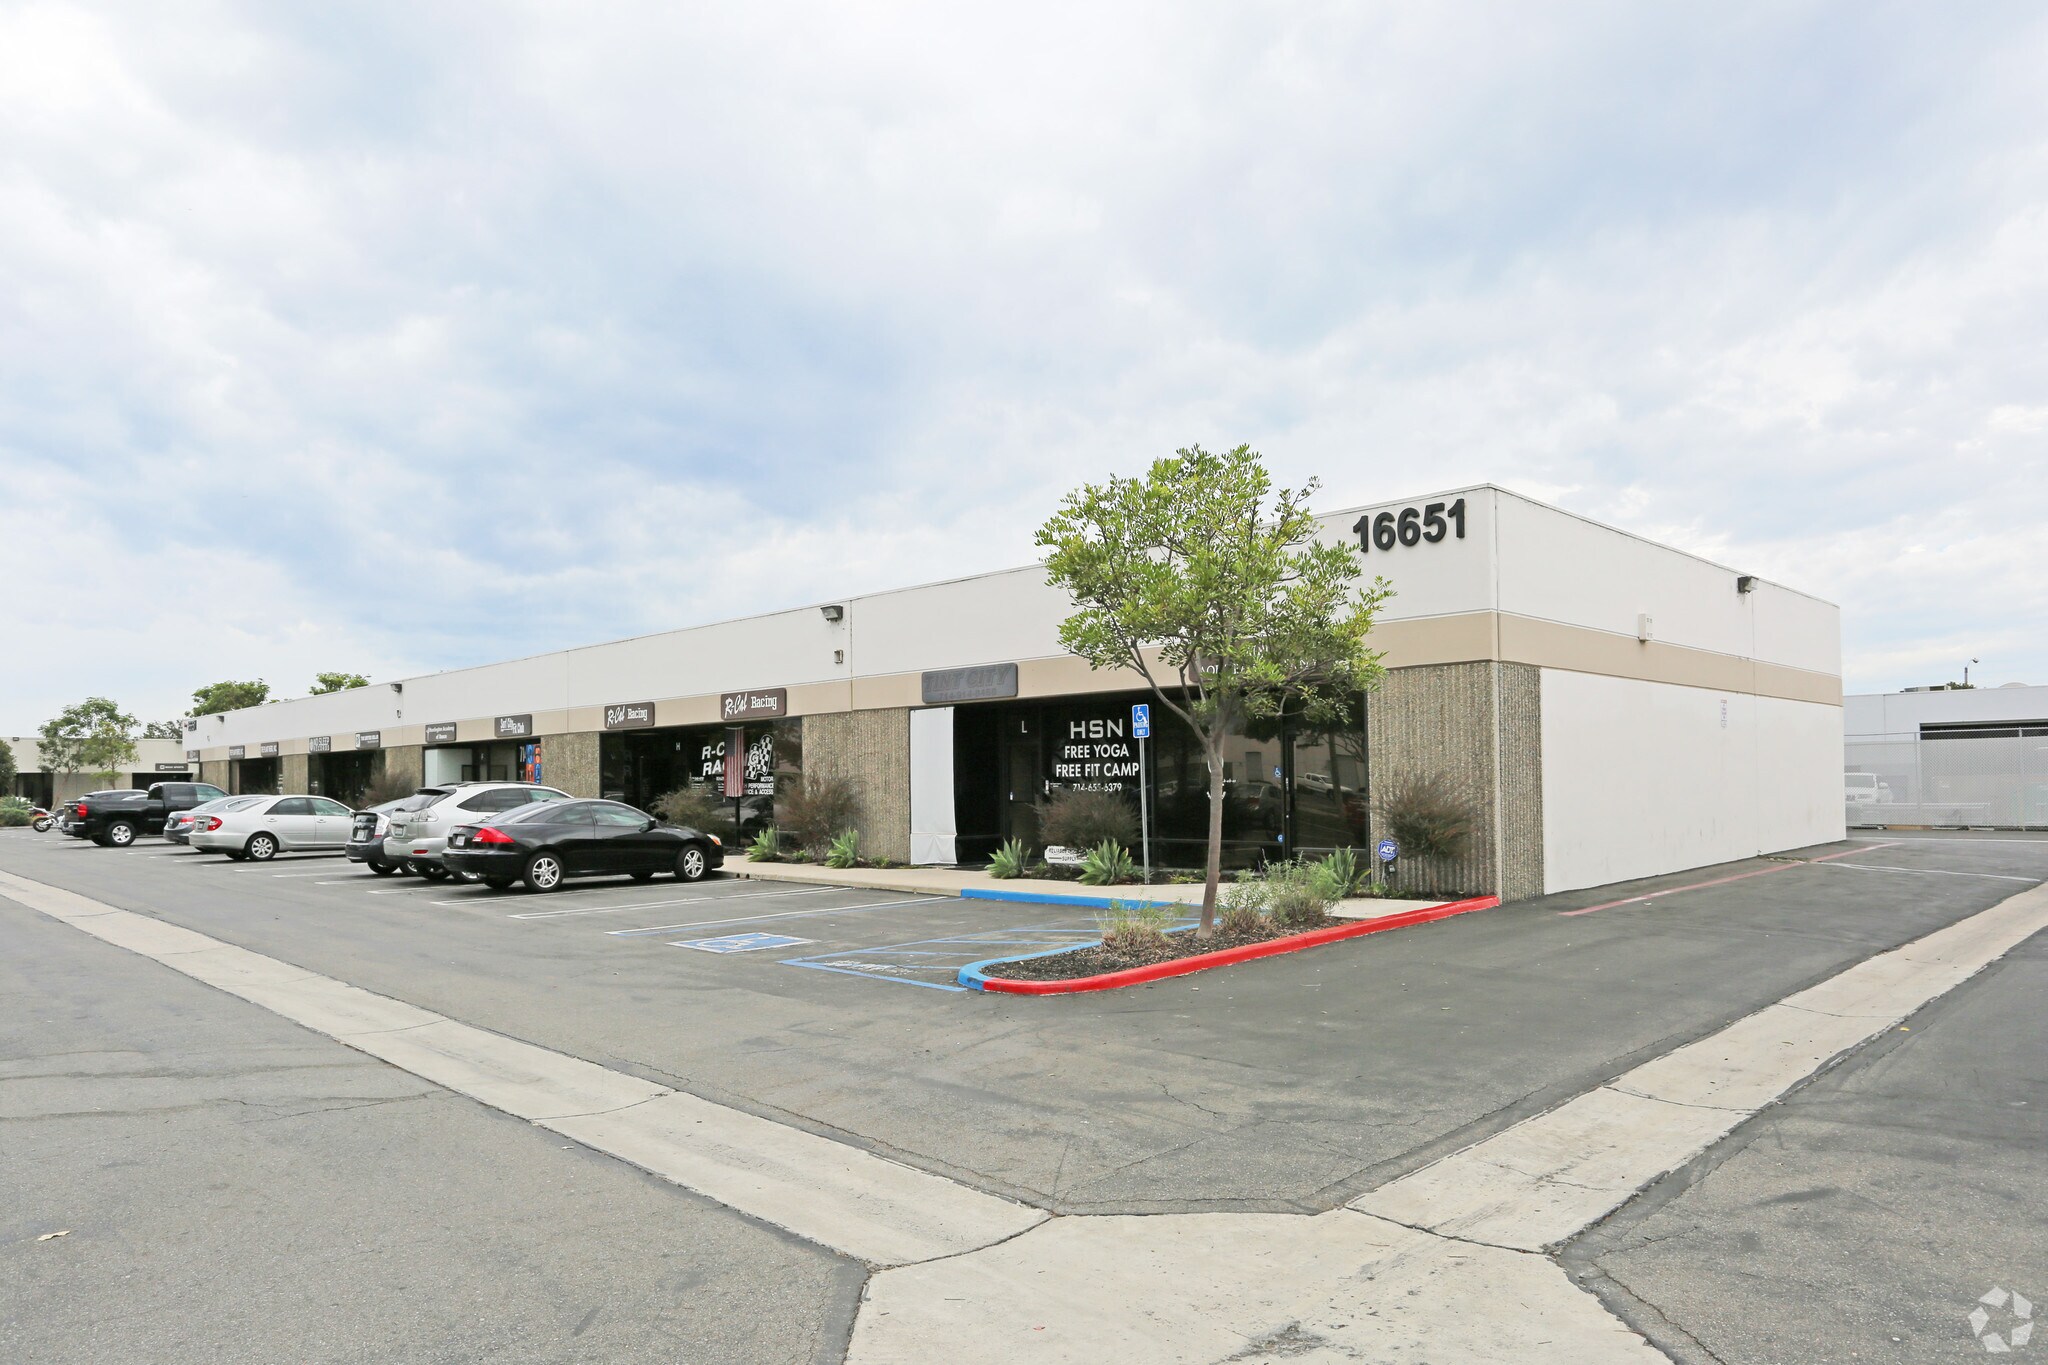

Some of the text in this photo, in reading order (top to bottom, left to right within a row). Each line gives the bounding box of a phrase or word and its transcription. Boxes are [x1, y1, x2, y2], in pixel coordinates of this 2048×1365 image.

[1352, 498, 1465, 554] 16651
[966, 664, 1012, 689] CITY
[750, 694, 778, 711] Racing
[627, 707, 648, 722] Racing
[1021, 720, 1028, 733] L
[1070, 718, 1123, 739] HSN
[1064, 743, 1130, 759] FREE YOGA
[1056, 762, 1140, 778] FREE FIT CAMP
[1380, 846, 1395, 854] ADT
